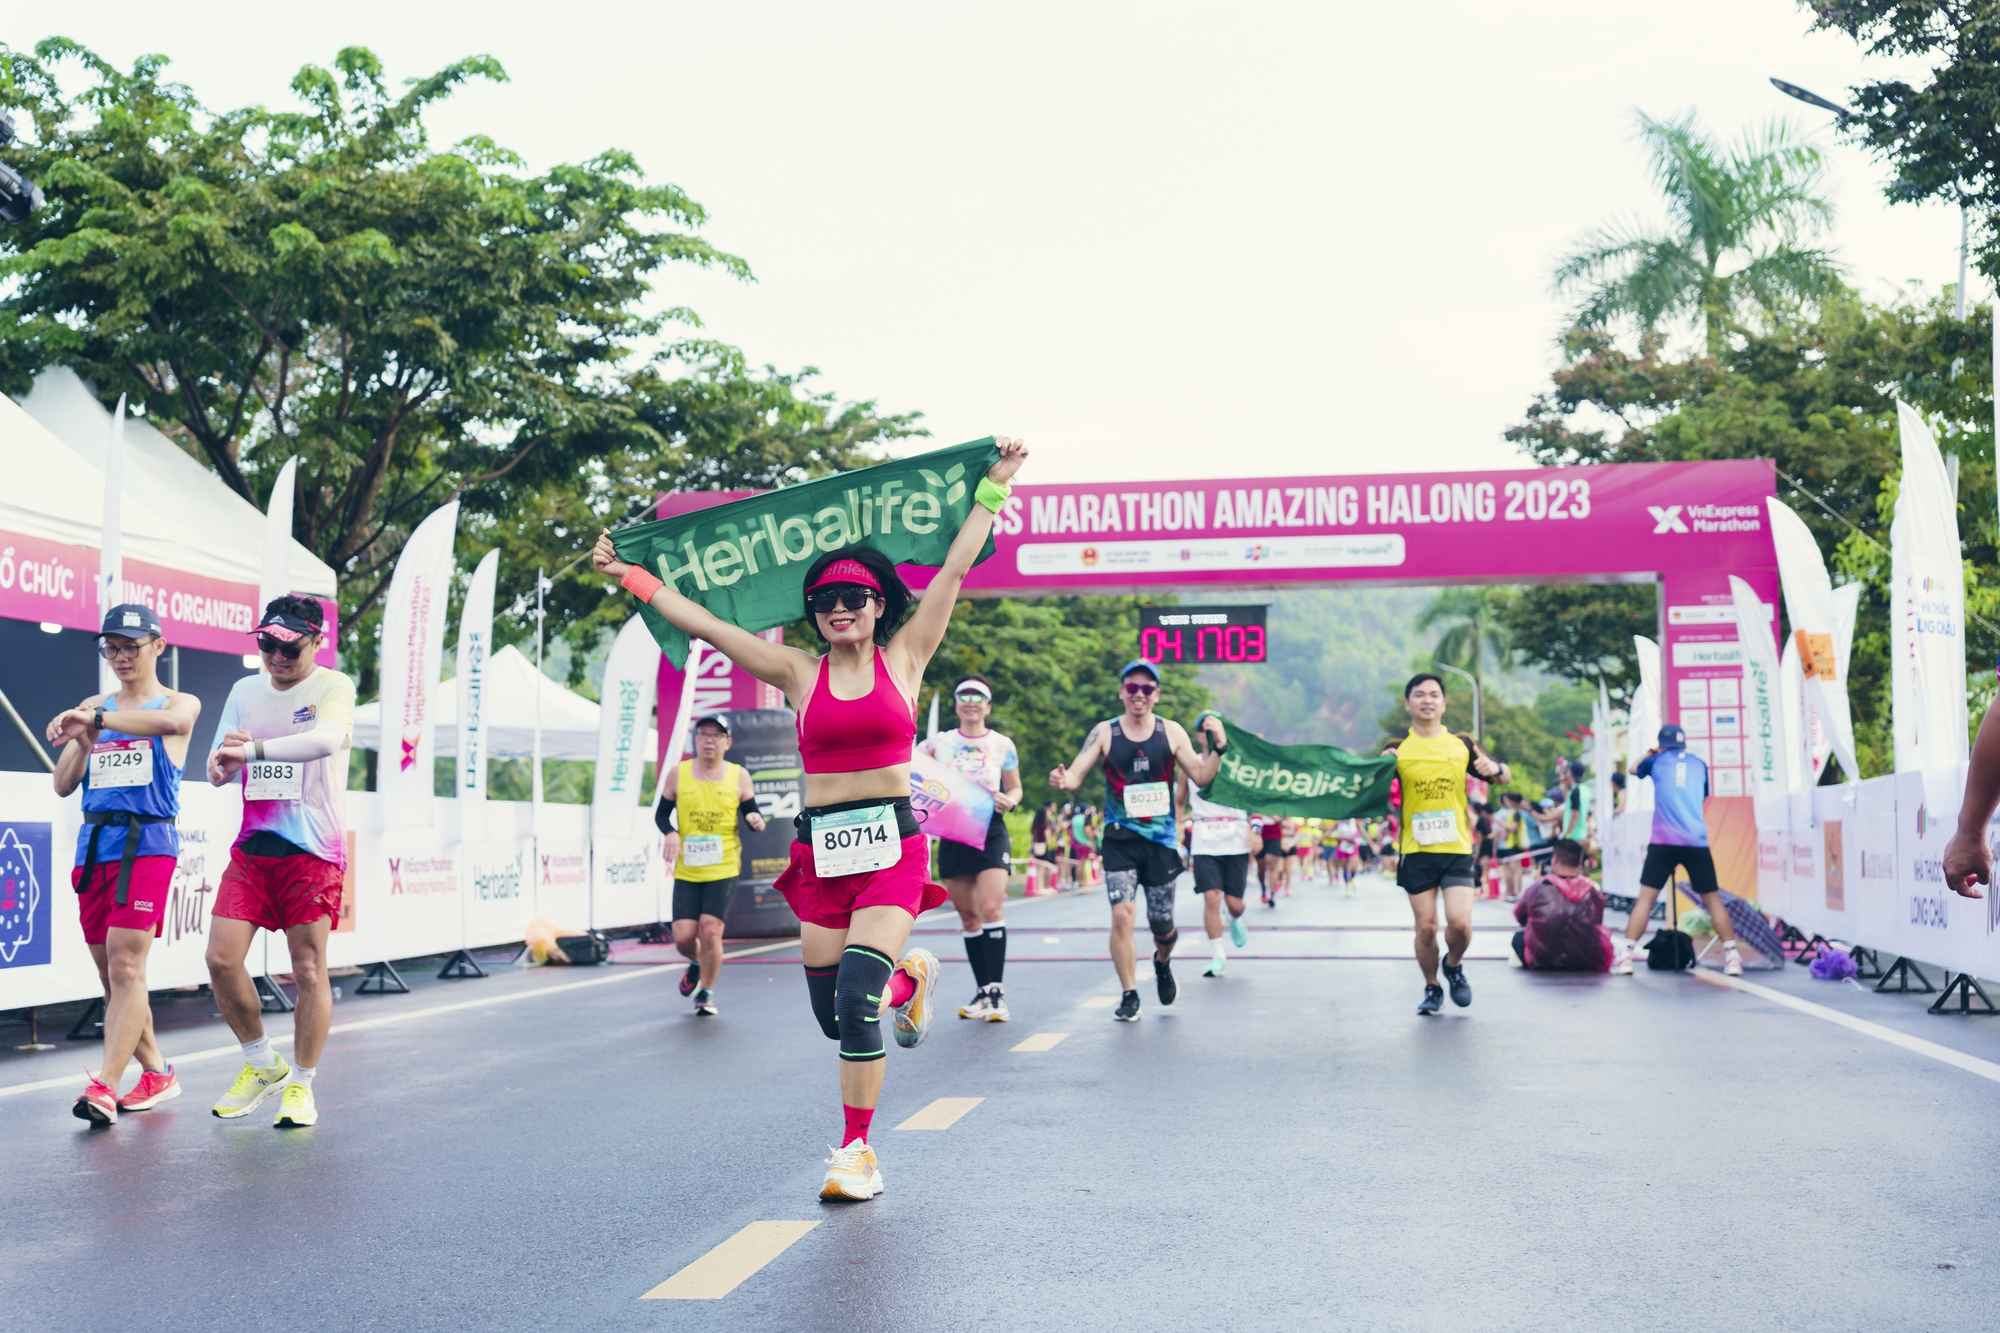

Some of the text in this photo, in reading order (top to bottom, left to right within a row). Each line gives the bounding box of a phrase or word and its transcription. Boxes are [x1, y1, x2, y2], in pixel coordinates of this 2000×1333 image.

[1031, 492, 1205, 534] MARATHON
[1213, 485, 1360, 530] AMAZING
[1367, 481, 1496, 524] HALONG
[1504, 478, 1591, 521] 2023
[1687, 504, 1760, 519] VnExpress
[1693, 518, 1760, 532] Marathon
[656, 478, 943, 593] Herbalife
[0, 546, 75, 600] Ổ CHỨC
[156, 588, 168, 618] &
[170, 591, 253, 632] ORGANIZER
[98, 752, 143, 769] 91249
[252, 765, 293, 779] 81883
[754, 780, 800, 793] ERBALIFE
[1131, 792, 1163, 803] 80237
[1418, 821, 1450, 831] 83128
[824, 824, 888, 851] 80714
[167, 877, 213, 947] Nut
